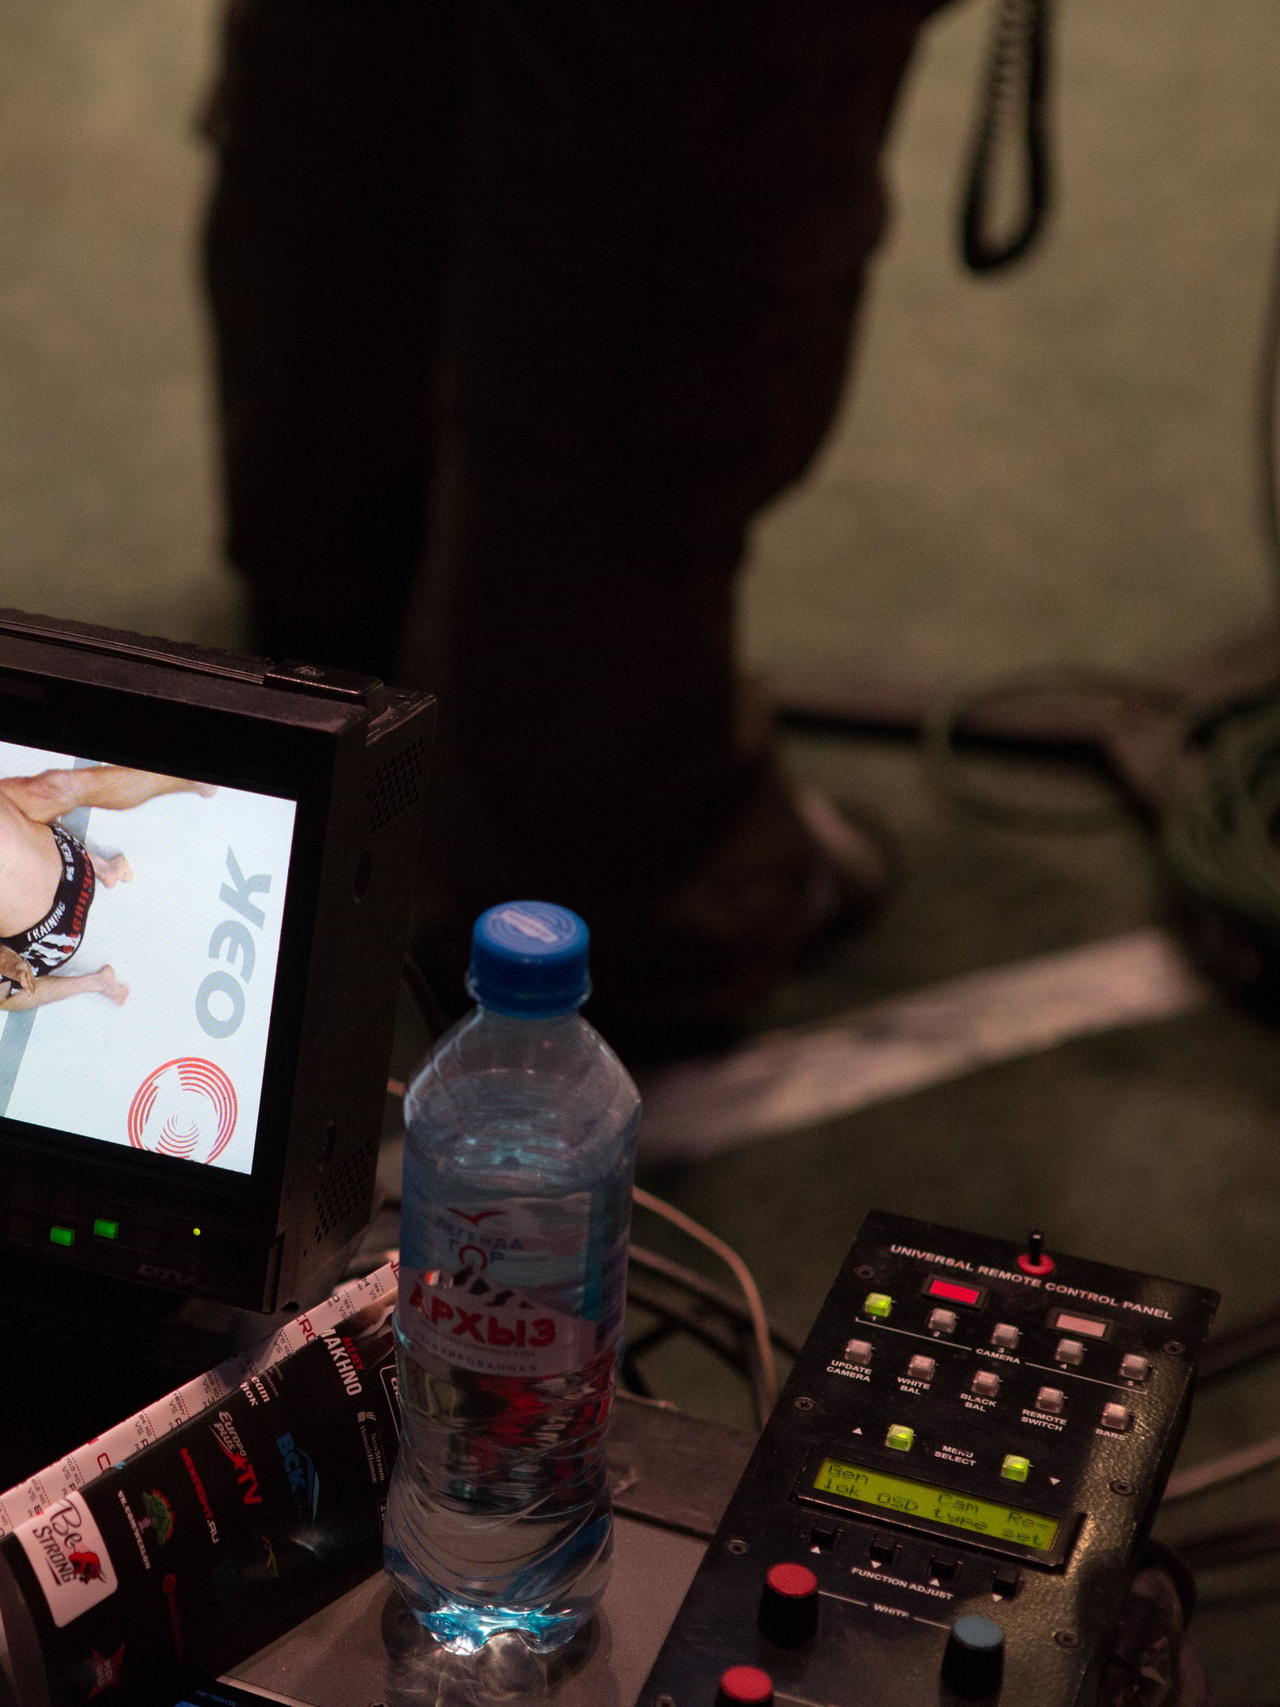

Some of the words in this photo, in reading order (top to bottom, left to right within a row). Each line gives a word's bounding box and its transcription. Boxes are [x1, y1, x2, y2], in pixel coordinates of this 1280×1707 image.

[890, 1244, 974, 1273] UNIVERSAL
[977, 1265, 1042, 1291] REMOTE
[1044, 1282, 1120, 1307] CONTROL
[1122, 1300, 1173, 1321] PANEL
[410, 1282, 556, 1348] АРХЫЗ
[342, 1336, 365, 1370] ALEXEY
[976, 1348, 1021, 1365] CAMERA
[826, 1366, 871, 1383] CAMERA
[830, 1359, 873, 1376] UPDATE
[896, 1376, 932, 1392] WHITE
[900, 1384, 923, 1396] BAL
[960, 1392, 997, 1408] BLACK
[964, 1401, 987, 1413] BAL
[1020, 1416, 1064, 1433] SWITCH
[1021, 1409, 1068, 1427] REMOTE
[1095, 1428, 1126, 1442] BARS
[933, 1450, 978, 1467] SELECT
[942, 1444, 975, 1459] MENU
[237, 1463, 264, 1506] TV
[826, 1463, 871, 1486] Gen
[937, 1492, 981, 1514] Cam
[50, 1498, 83, 1551] Be
[933, 1507, 989, 1532] type
[1001, 1527, 1045, 1548] set
[32, 1525, 77, 1584] STRONG
[850, 1566, 909, 1589] FUNCTION
[907, 1583, 955, 1601] ADJUST
